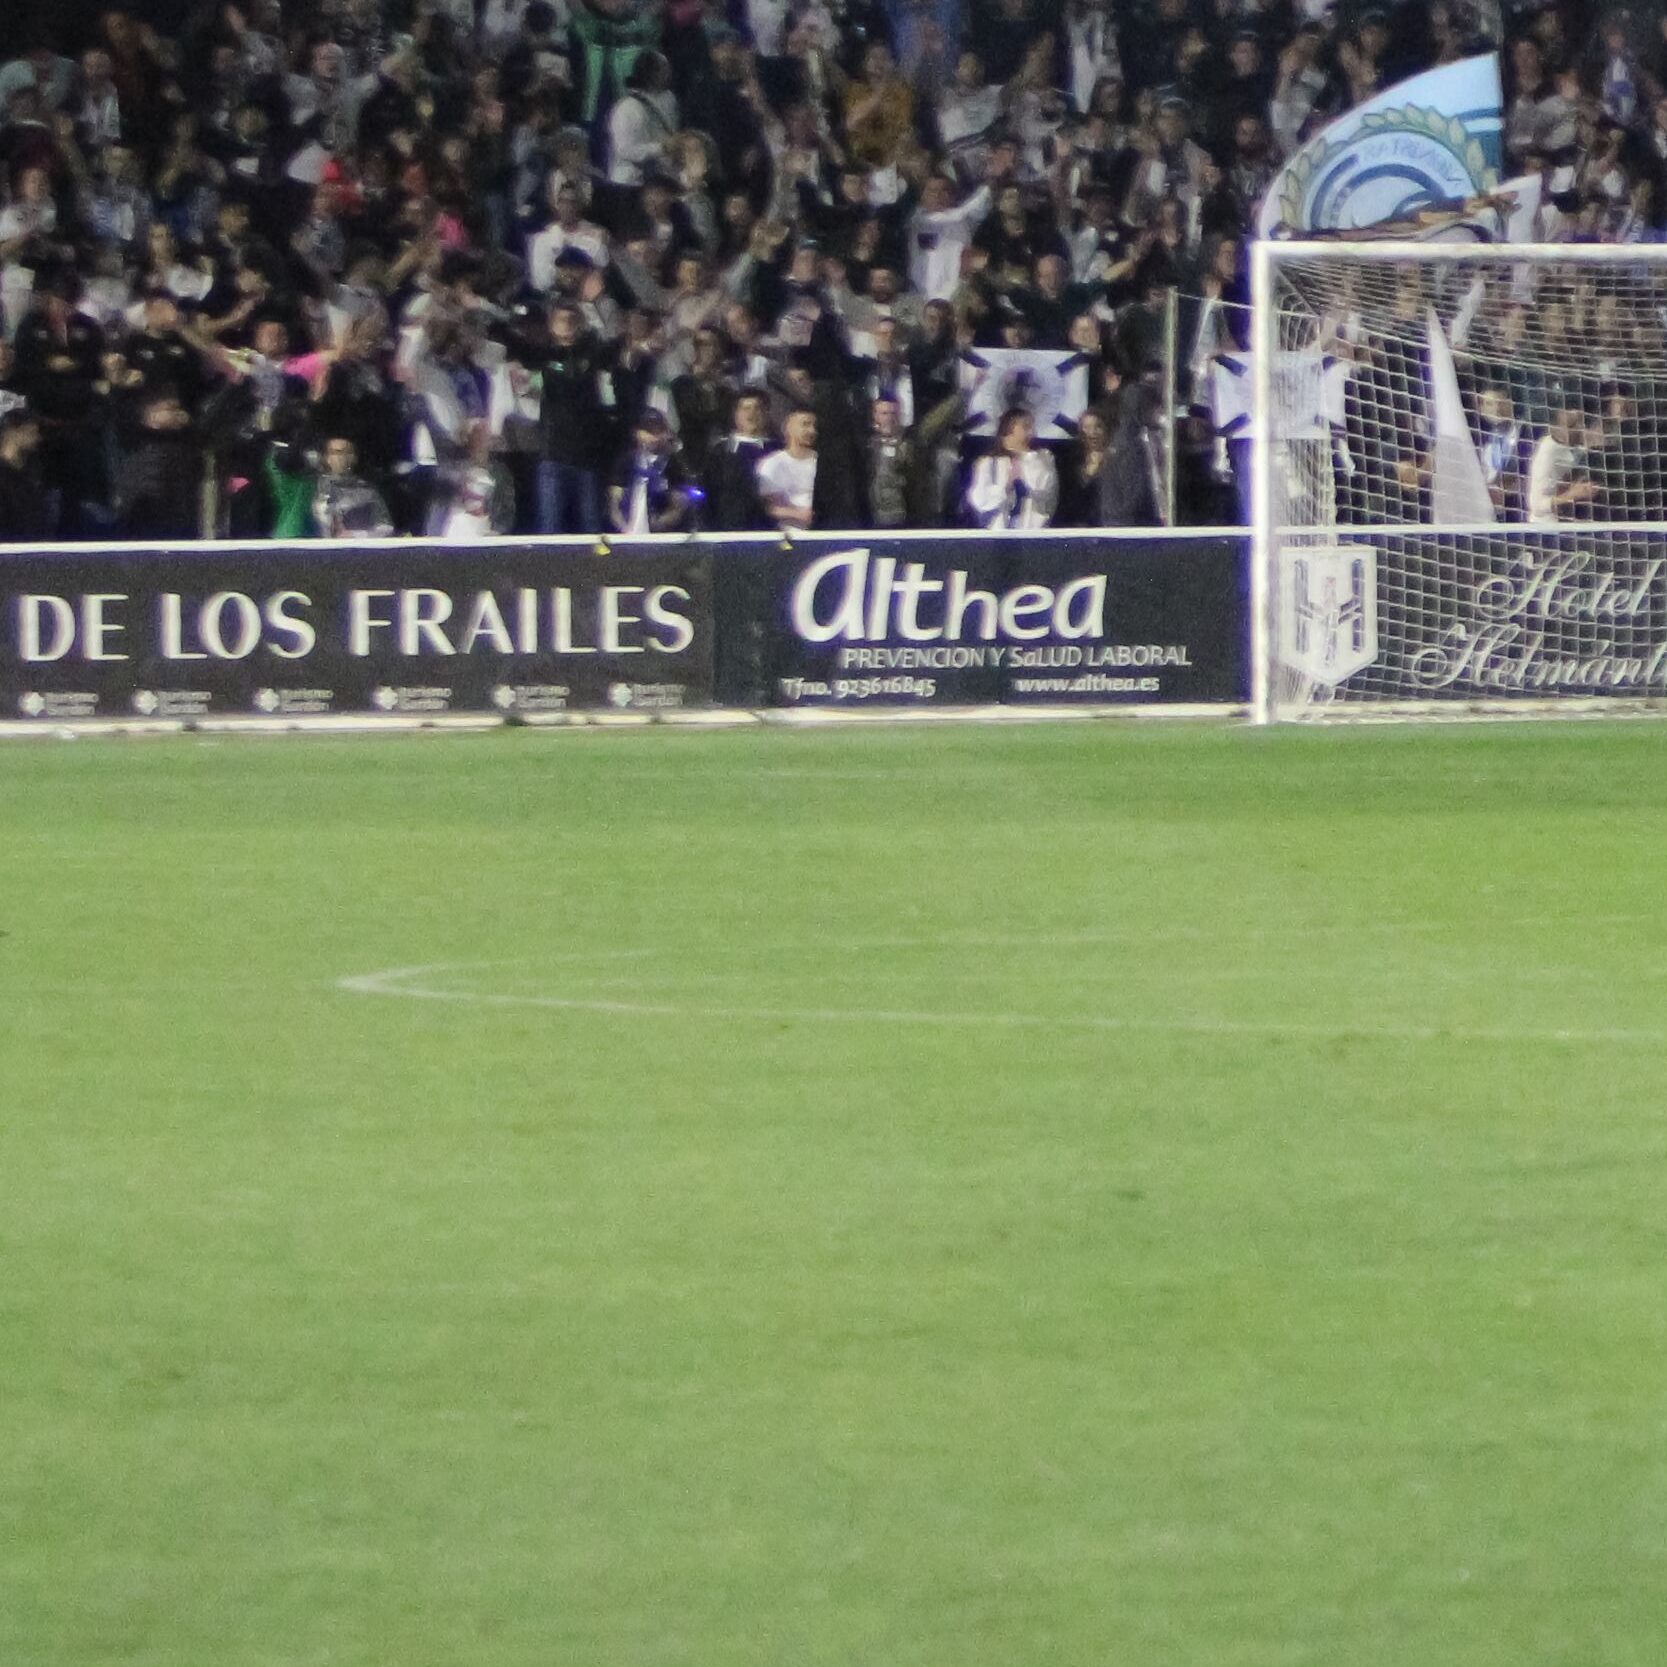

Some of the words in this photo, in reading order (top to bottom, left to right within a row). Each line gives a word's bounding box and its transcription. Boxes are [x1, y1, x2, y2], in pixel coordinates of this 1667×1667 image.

[1477, 551, 1666, 619] Hotel
[19, 593, 130, 662] DE
[157, 590, 317, 661] LOS
[348, 584, 695, 657] FRAILES
[843, 648, 986, 669] PREVENCION
[990, 647, 1006, 667] Y
[1087, 645, 1194, 667] LABORAL
[1014, 674, 1162, 693] www.althea.es
